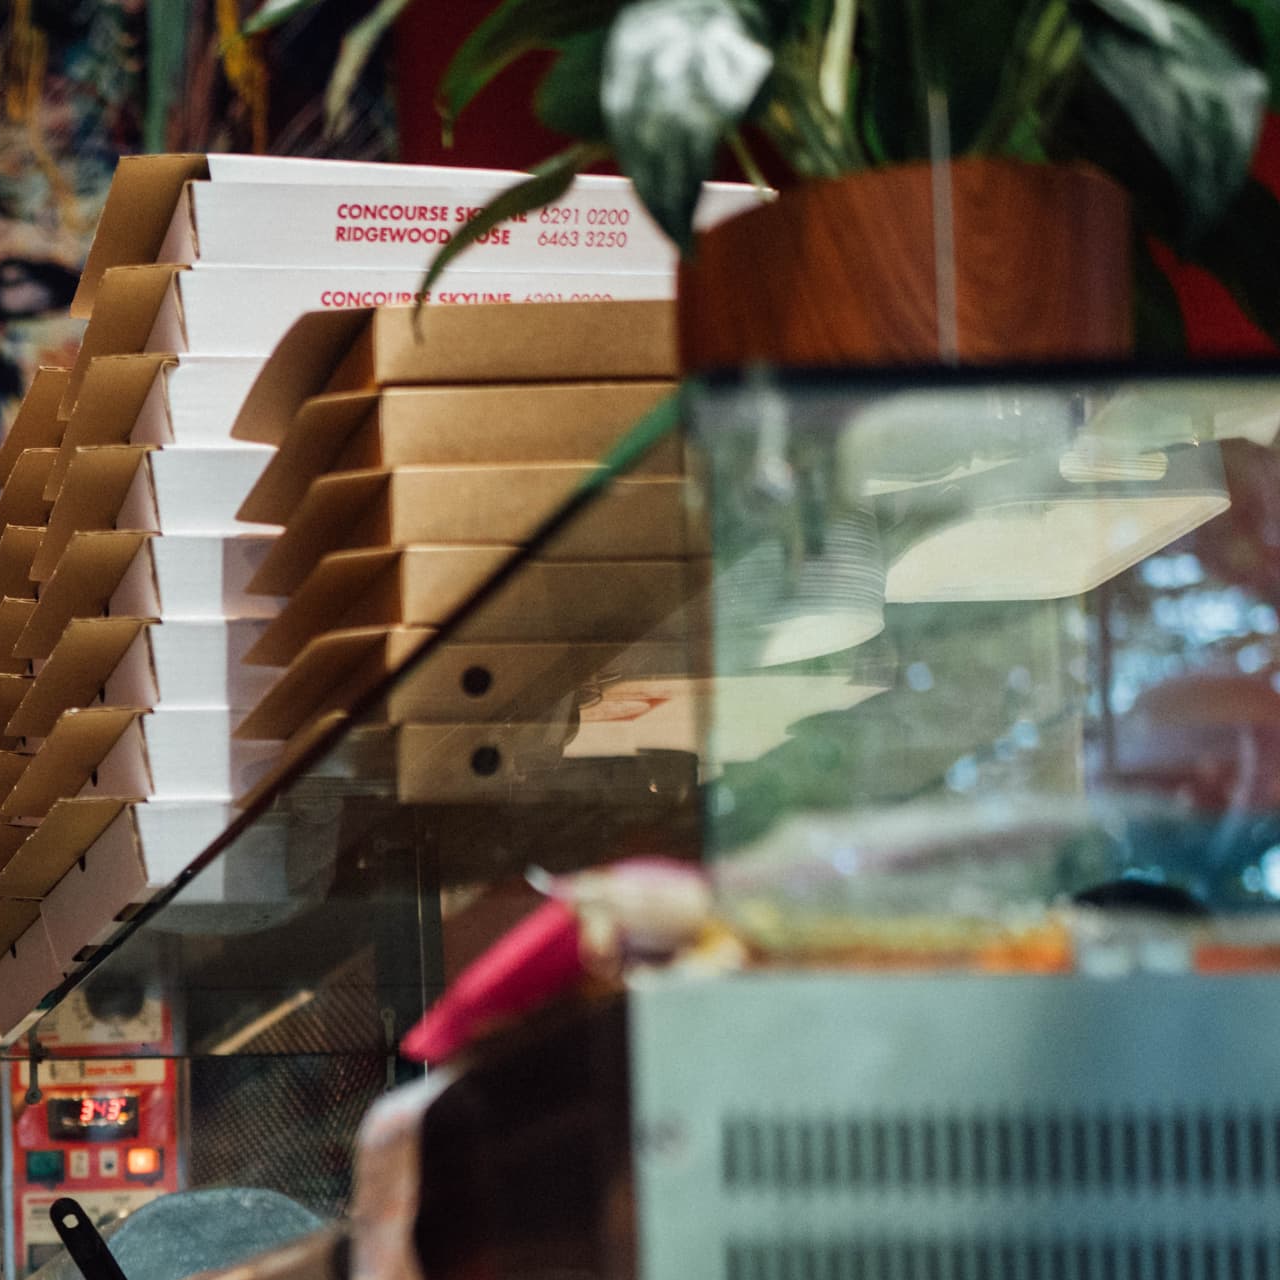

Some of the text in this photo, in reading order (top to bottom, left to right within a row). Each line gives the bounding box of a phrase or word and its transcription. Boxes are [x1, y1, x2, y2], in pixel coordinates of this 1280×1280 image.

[336, 204, 449, 223] CONCOURSE
[539, 206, 580, 226] 6291
[586, 208, 630, 226] 0200
[335, 226, 450, 246] RIDGEWOOD
[538, 230, 580, 248] 6463
[585, 231, 628, 249] 3250
